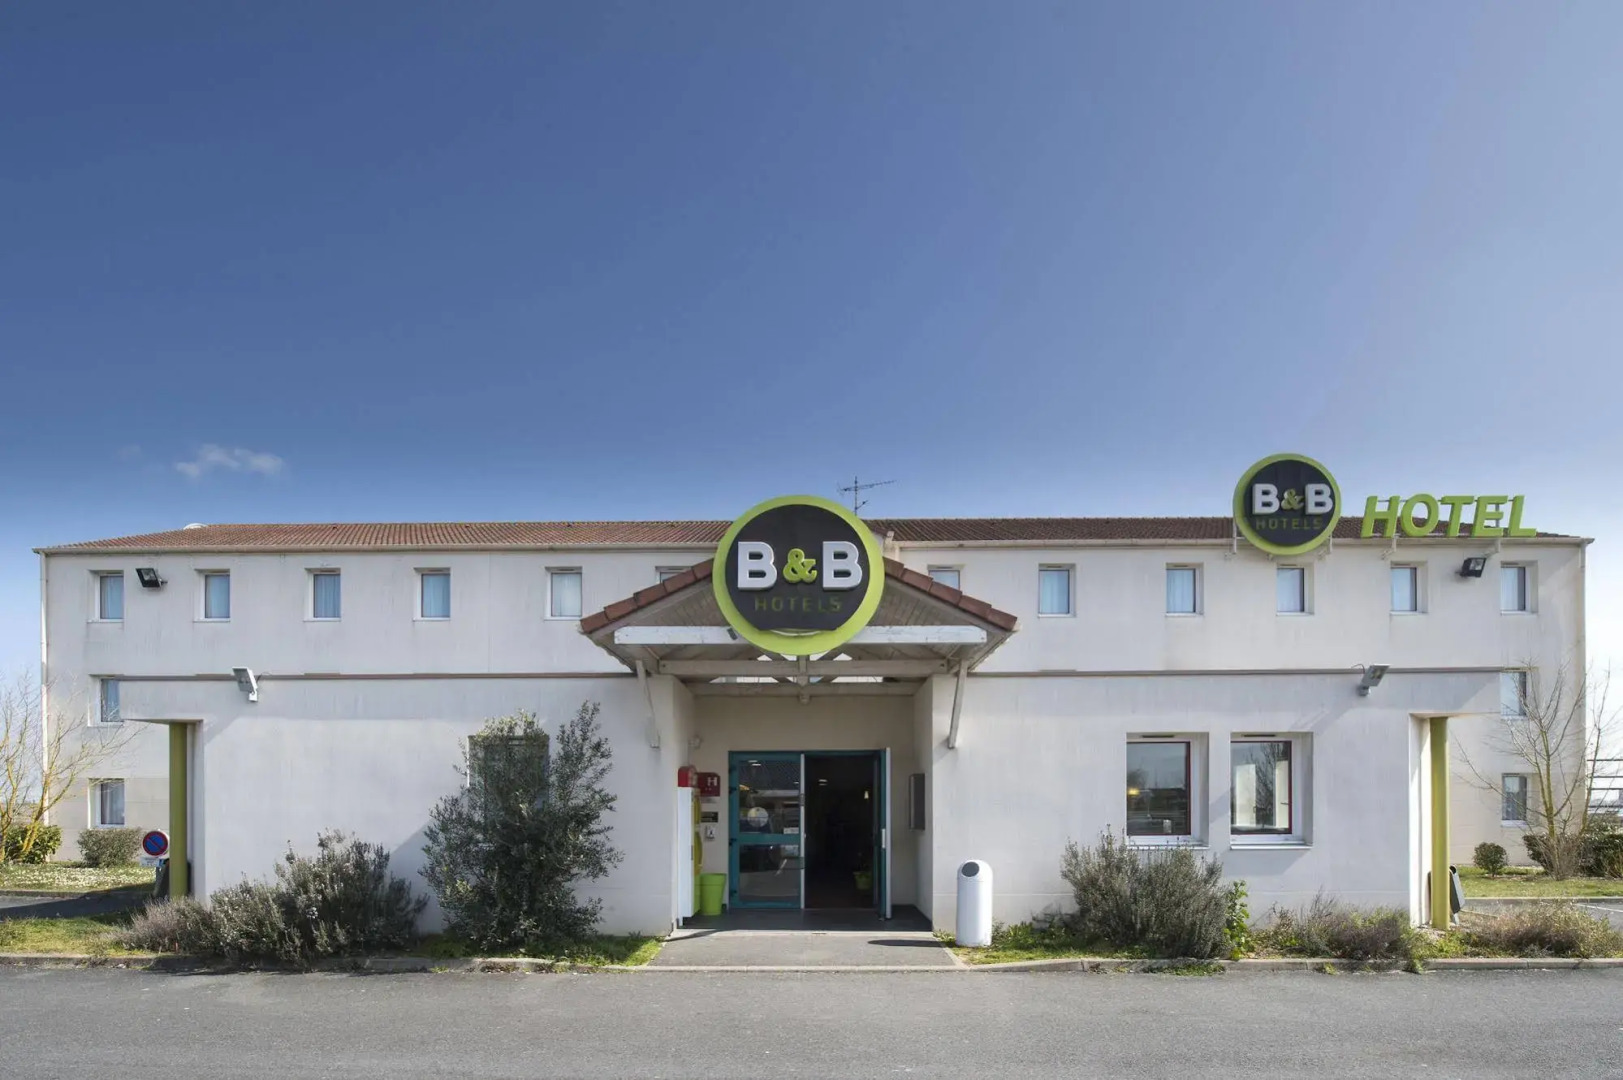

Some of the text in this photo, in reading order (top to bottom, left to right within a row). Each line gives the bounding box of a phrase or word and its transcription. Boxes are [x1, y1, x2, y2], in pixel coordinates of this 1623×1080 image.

[1252, 483, 1334, 515] B&B
[1255, 517, 1323, 531] HOTELS
[1360, 493, 1537, 538] HOTEL
[738, 541, 863, 590] B&B
[754, 596, 842, 612] HOTELS
